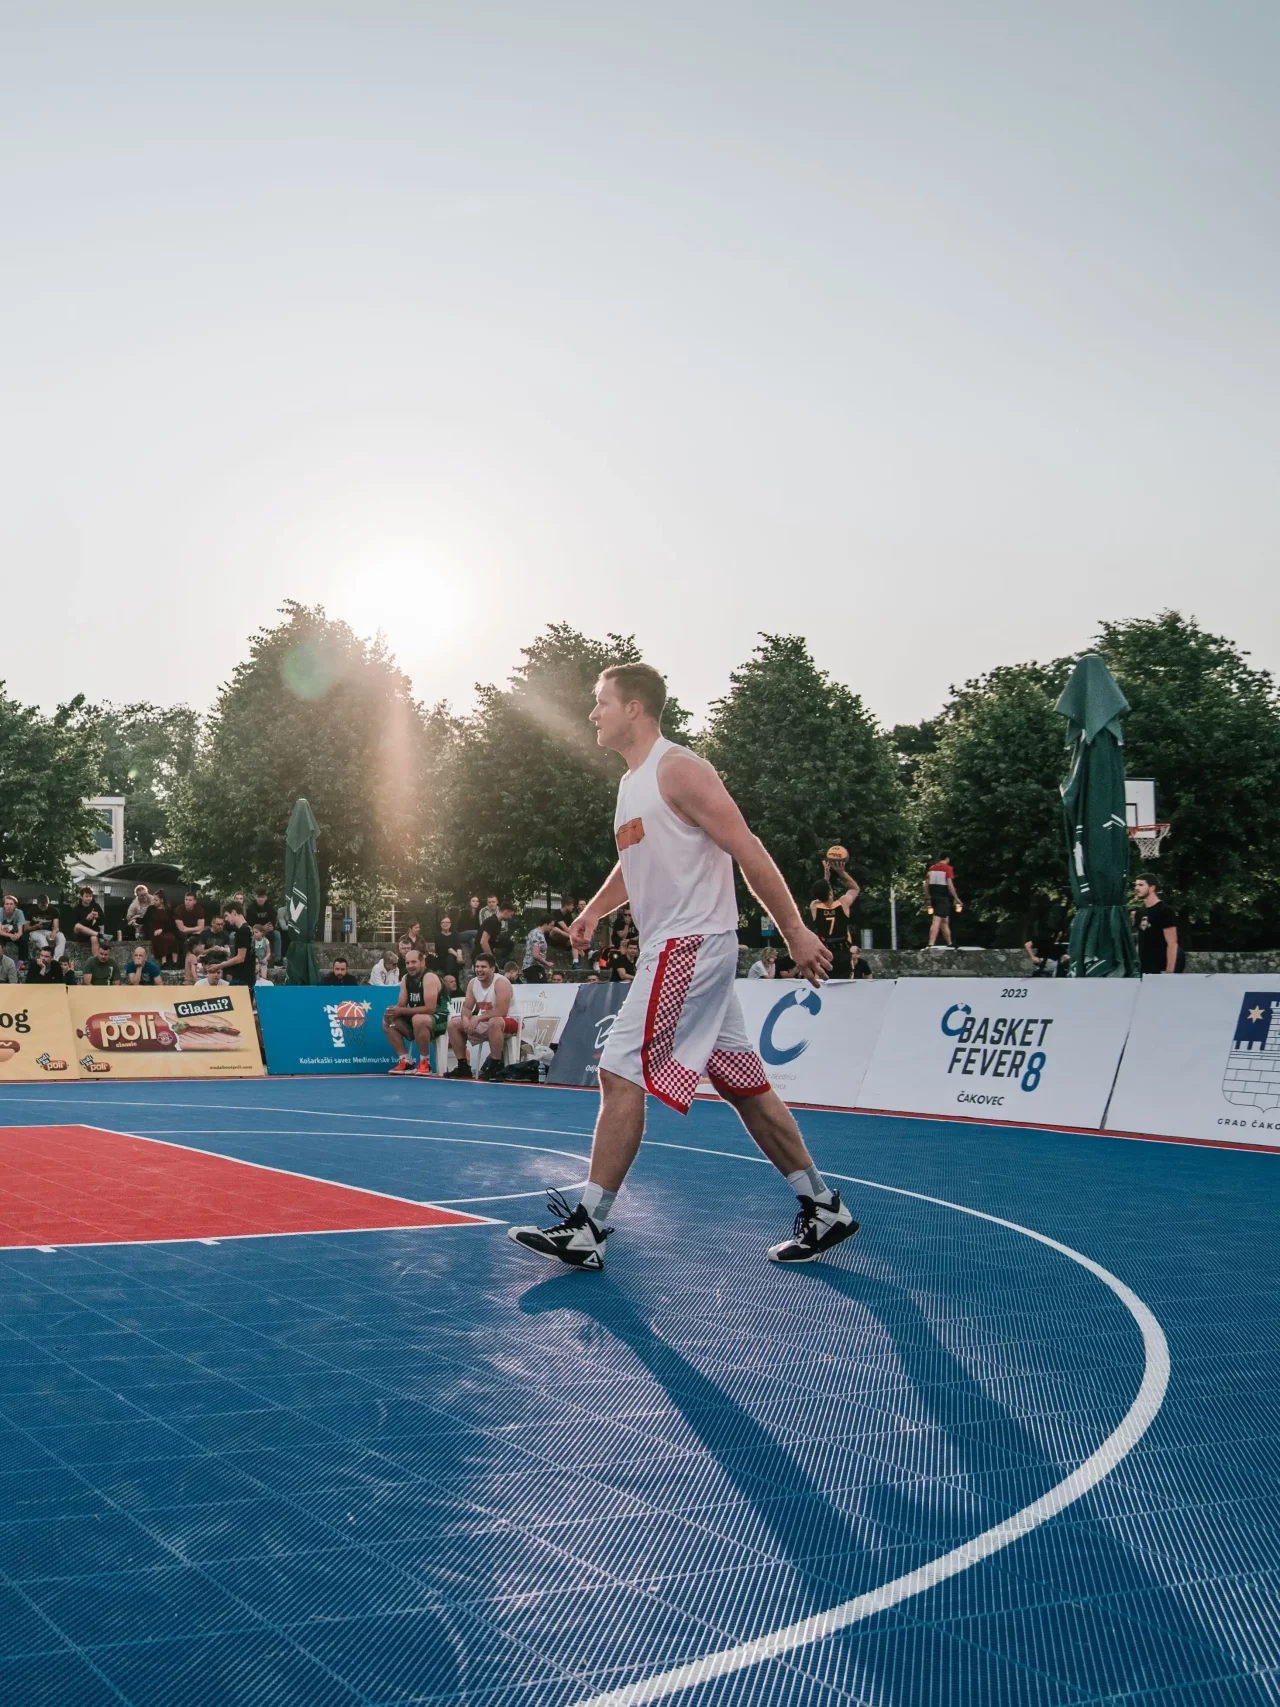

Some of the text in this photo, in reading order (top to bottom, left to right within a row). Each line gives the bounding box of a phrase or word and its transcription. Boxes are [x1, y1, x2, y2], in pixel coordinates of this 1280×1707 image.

[825, 917, 836, 935] 7
[1000, 988, 1028, 998] 2023
[177, 998, 230, 1016] Gladni?
[100, 1014, 157, 1047] poli
[957, 1016, 1053, 1047] BASKET
[47, 1060, 64, 1070] poli
[90, 1063, 107, 1072] poli
[299, 1056, 333, 1064] Košarkaški
[947, 1047, 1026, 1078] FEVER
[957, 1090, 1005, 1106] ČAKOVEC
[1217, 1118, 1280, 1131] GRAD ČAKO
